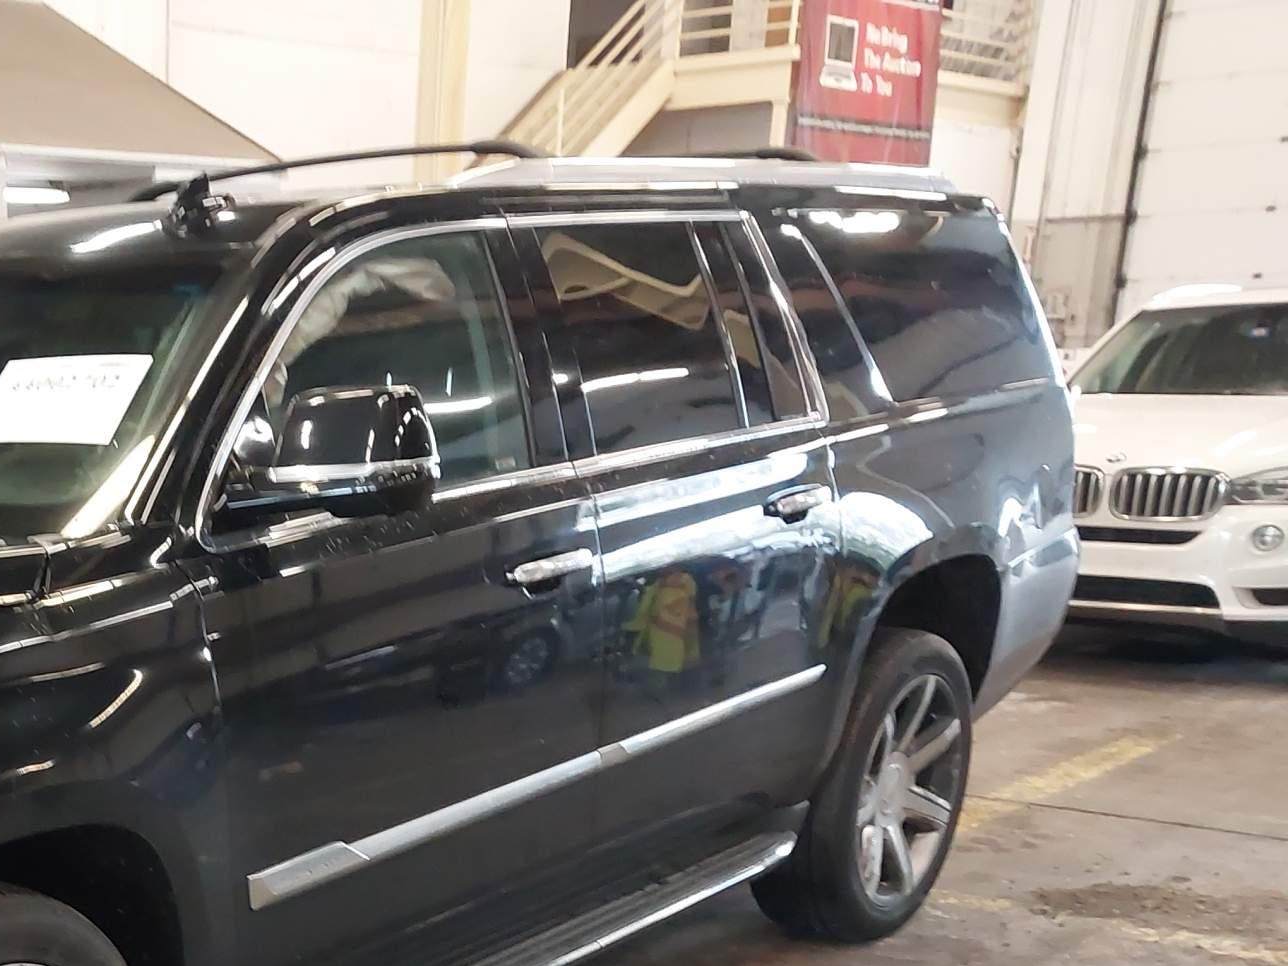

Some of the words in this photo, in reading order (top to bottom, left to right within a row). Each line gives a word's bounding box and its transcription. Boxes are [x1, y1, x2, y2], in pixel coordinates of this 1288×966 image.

[881, 25, 909, 54] Bring
[864, 48, 881, 70] The
[882, 51, 922, 77] Auction
[860, 72, 873, 94] To
[875, 74, 893, 97] You
